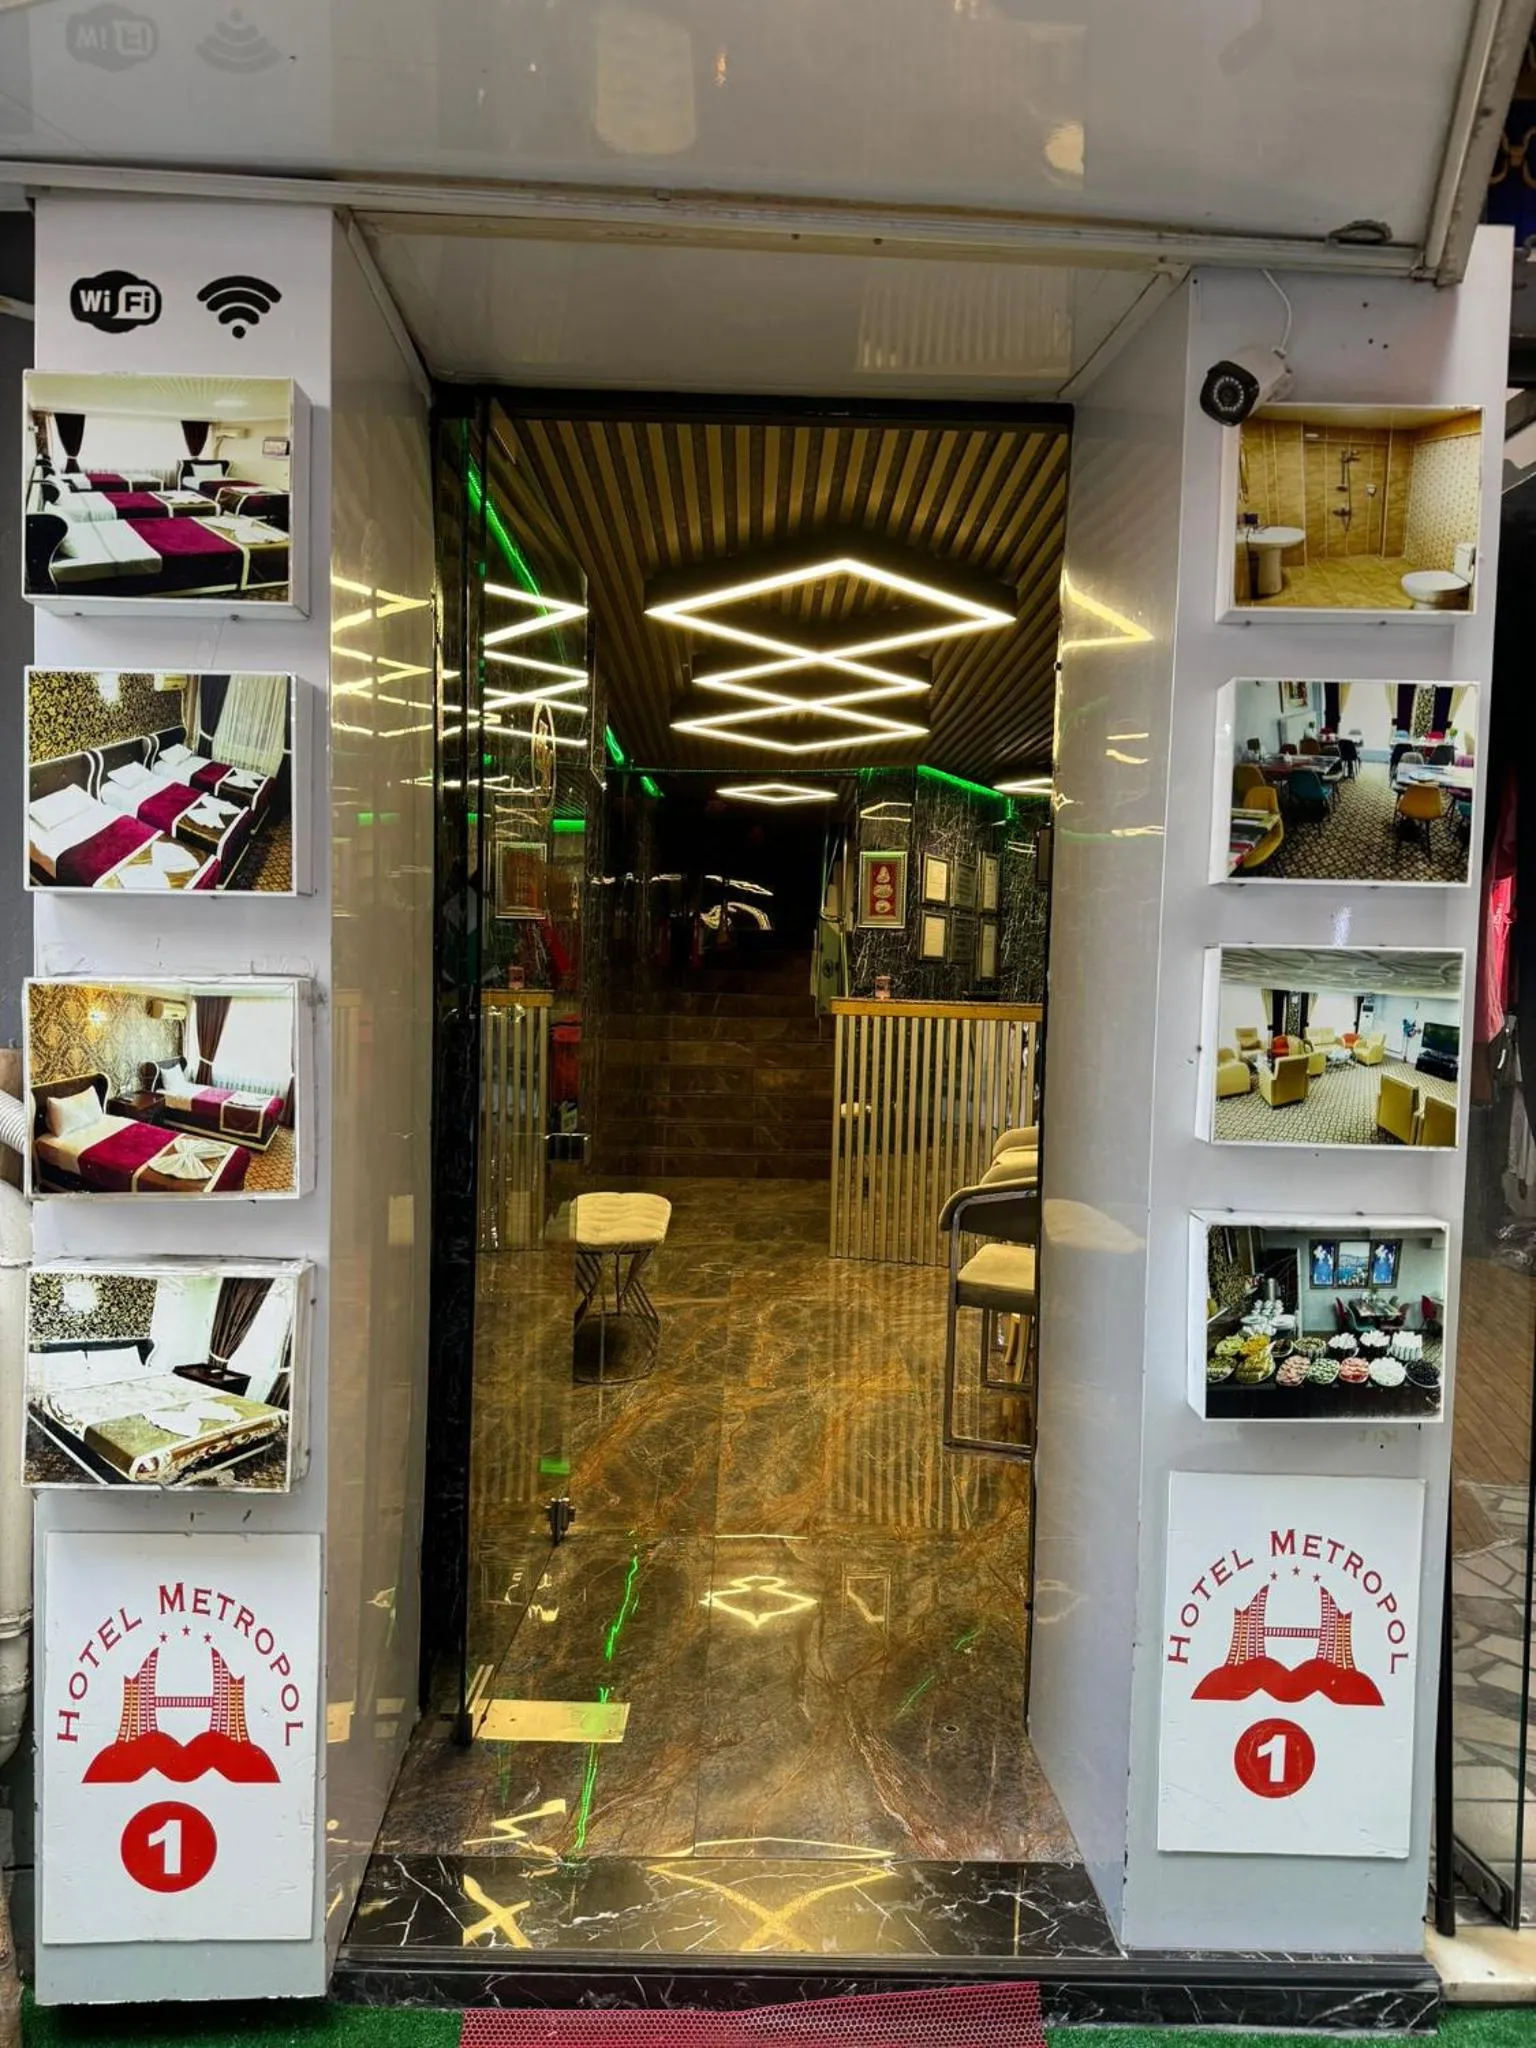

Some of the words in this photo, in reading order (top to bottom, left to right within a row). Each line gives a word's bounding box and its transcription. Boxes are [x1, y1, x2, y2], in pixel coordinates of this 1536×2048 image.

[1167, 1549, 1254, 1664] HOTEL
[1270, 1529, 1409, 1674] METROPOL
[57, 1608, 143, 1742] HOTEL
[159, 1582, 303, 1746] METROPOL
[1257, 1734, 1287, 1783] 1
[148, 1819, 182, 1874] 1
